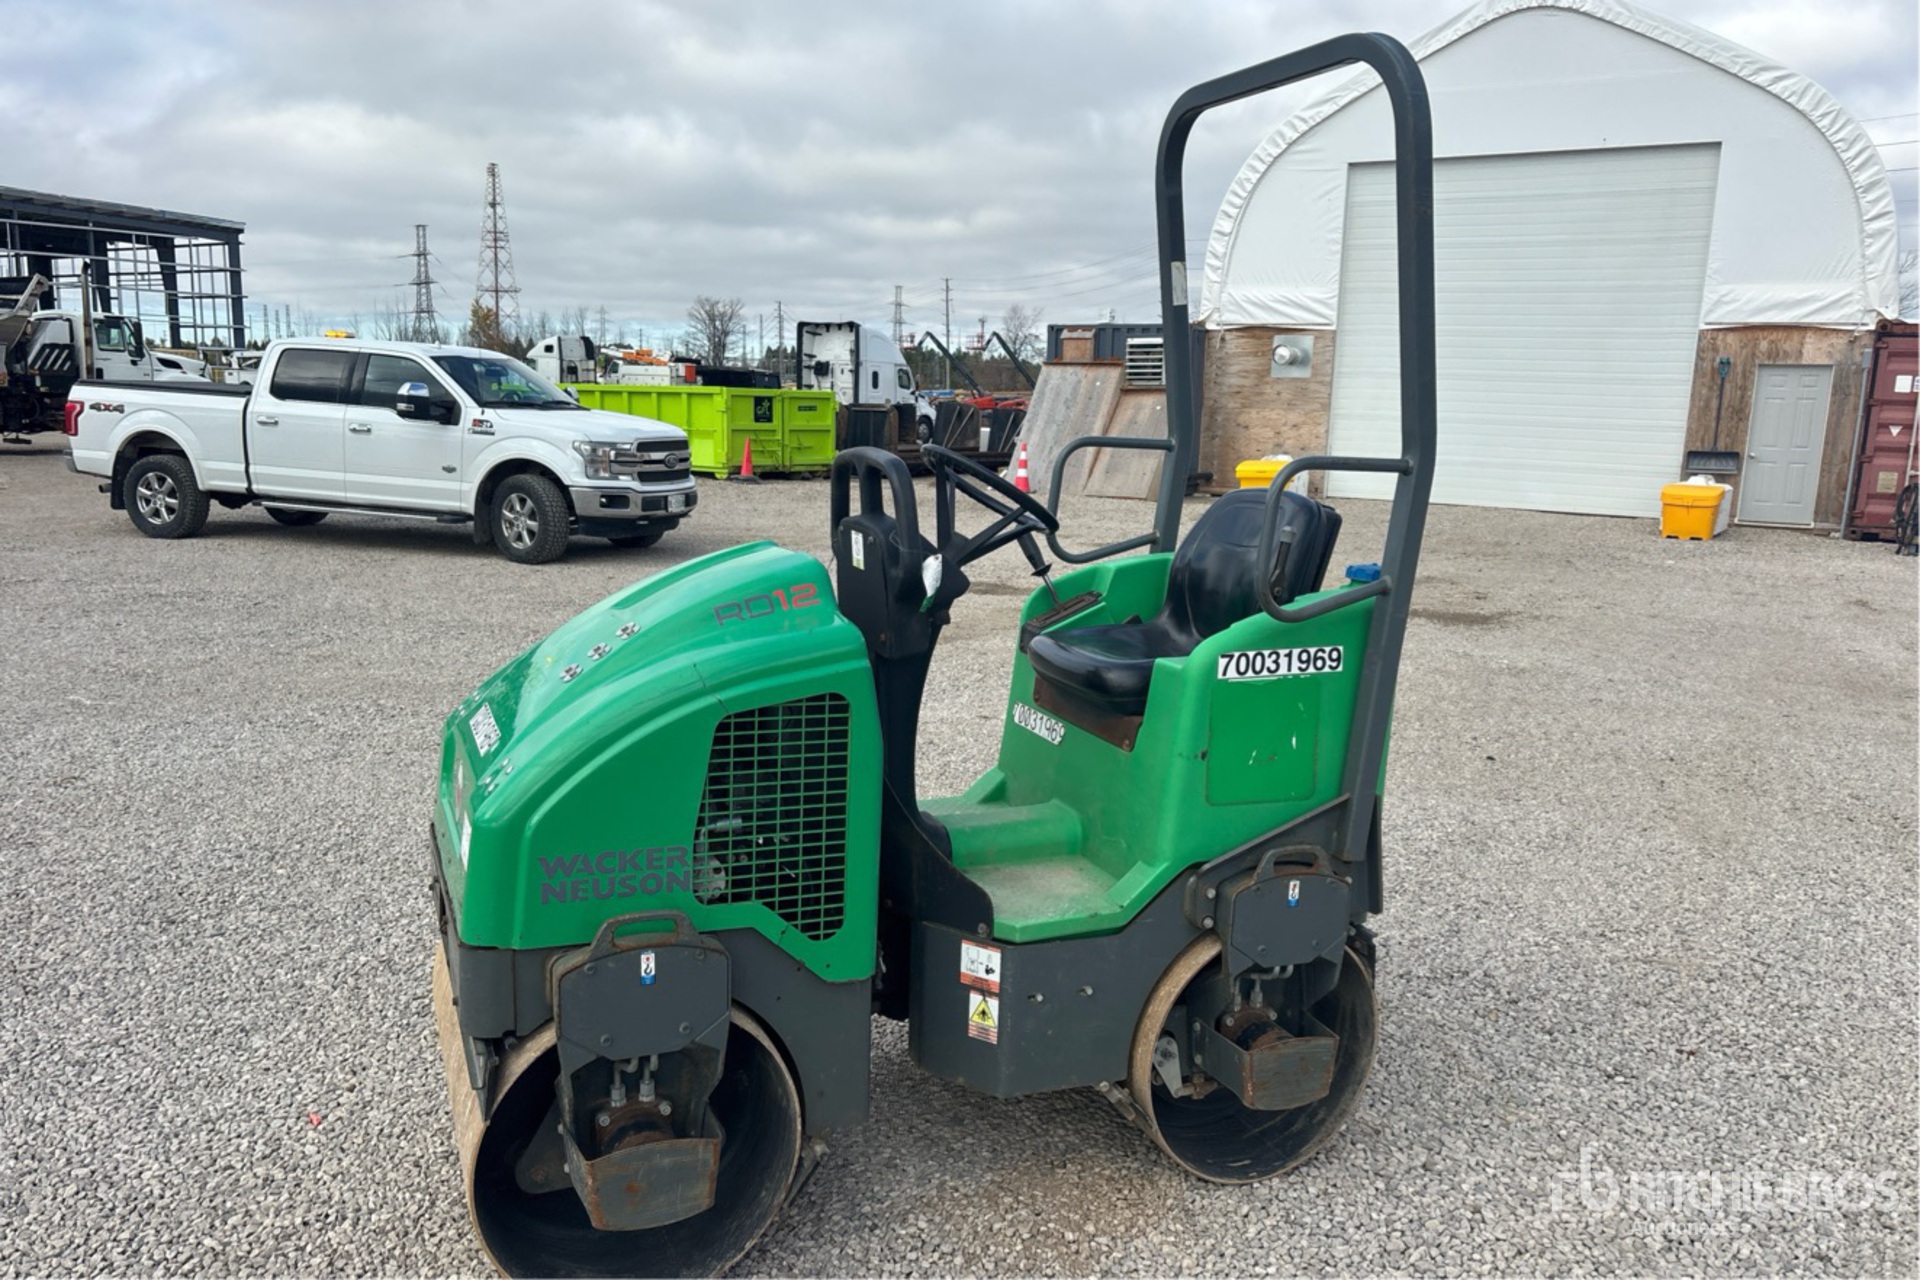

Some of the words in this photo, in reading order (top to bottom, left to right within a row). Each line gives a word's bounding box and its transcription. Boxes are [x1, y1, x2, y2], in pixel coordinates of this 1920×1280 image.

[713, 583, 820, 626] RD12
[1220, 647, 1342, 677] 70031969
[538, 845, 690, 879] WACKER
[541, 870, 691, 905] NEUSON
